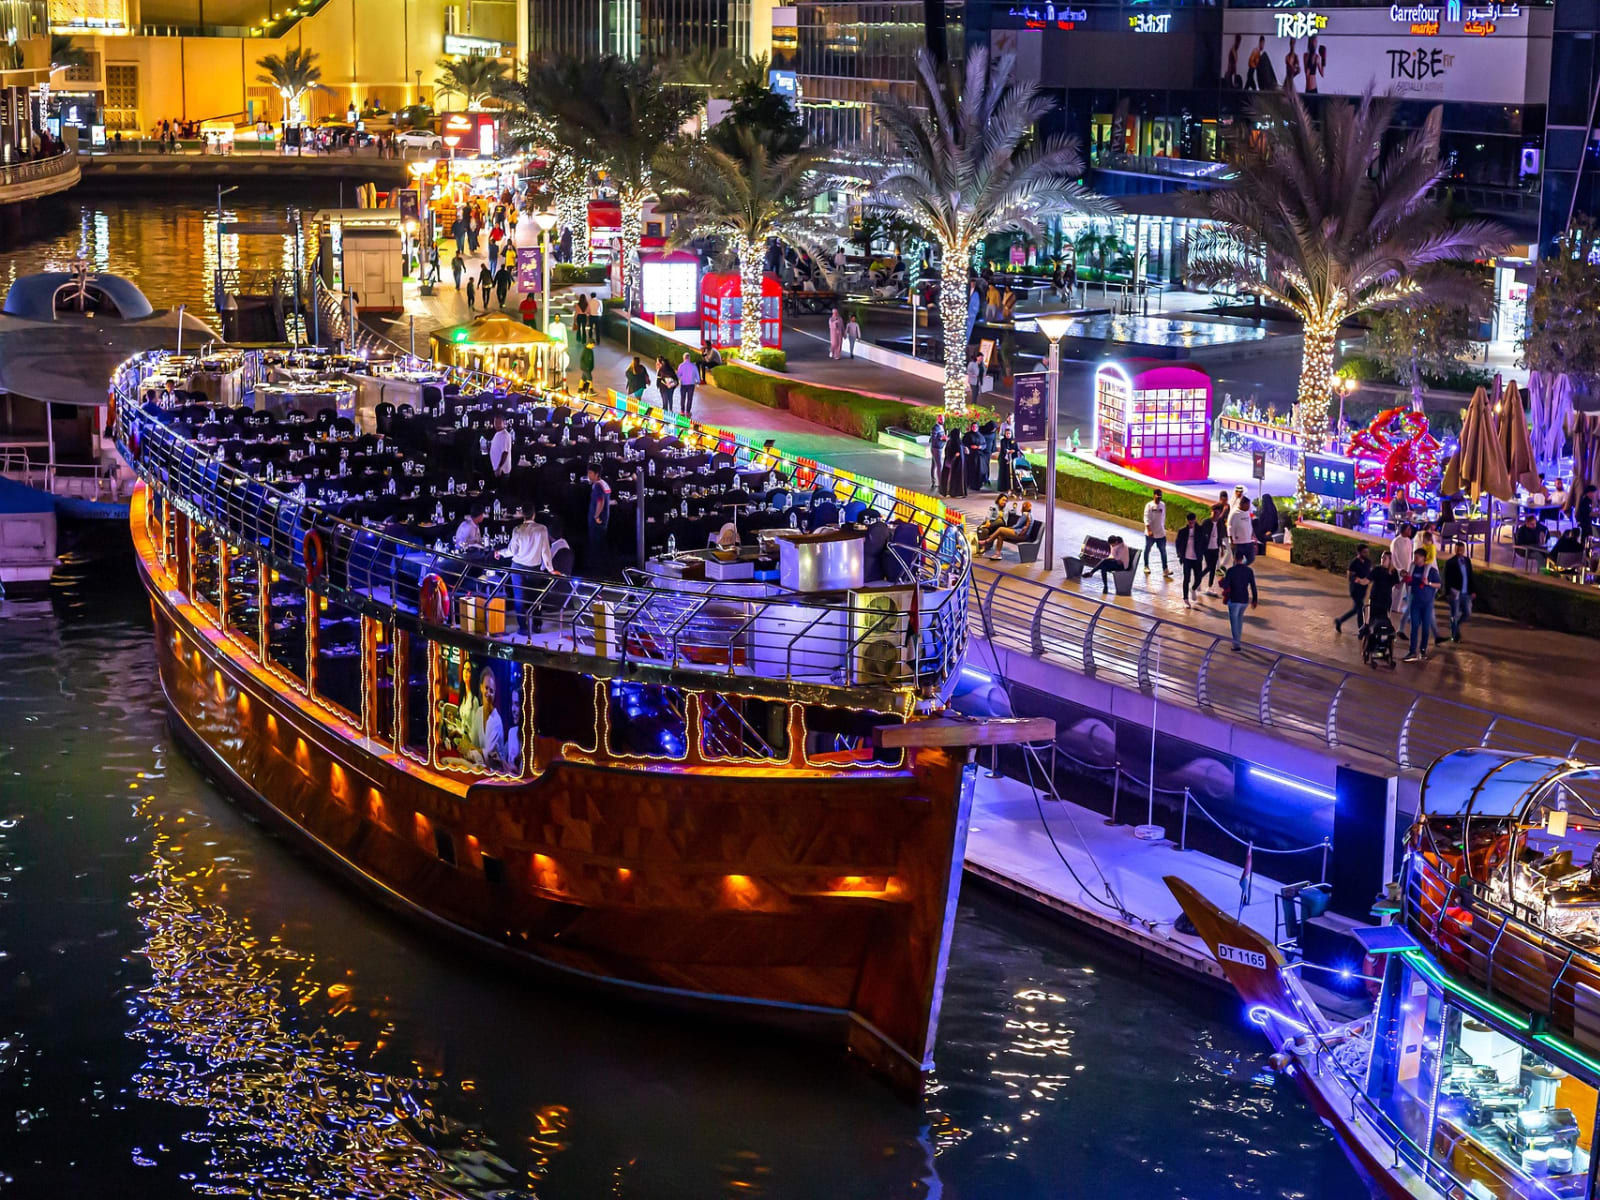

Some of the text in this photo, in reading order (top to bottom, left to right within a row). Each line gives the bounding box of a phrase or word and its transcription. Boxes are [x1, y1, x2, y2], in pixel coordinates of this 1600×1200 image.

[1390, 4, 1439, 22] Carrefour
[1466, 3, 1521, 21] كارفور
[1410, 22, 1440, 36] market
[1463, 22, 1496, 37] ماركت
[17, 101, 25, 120] PIER
[1219, 945, 1265, 967] DT 1165
